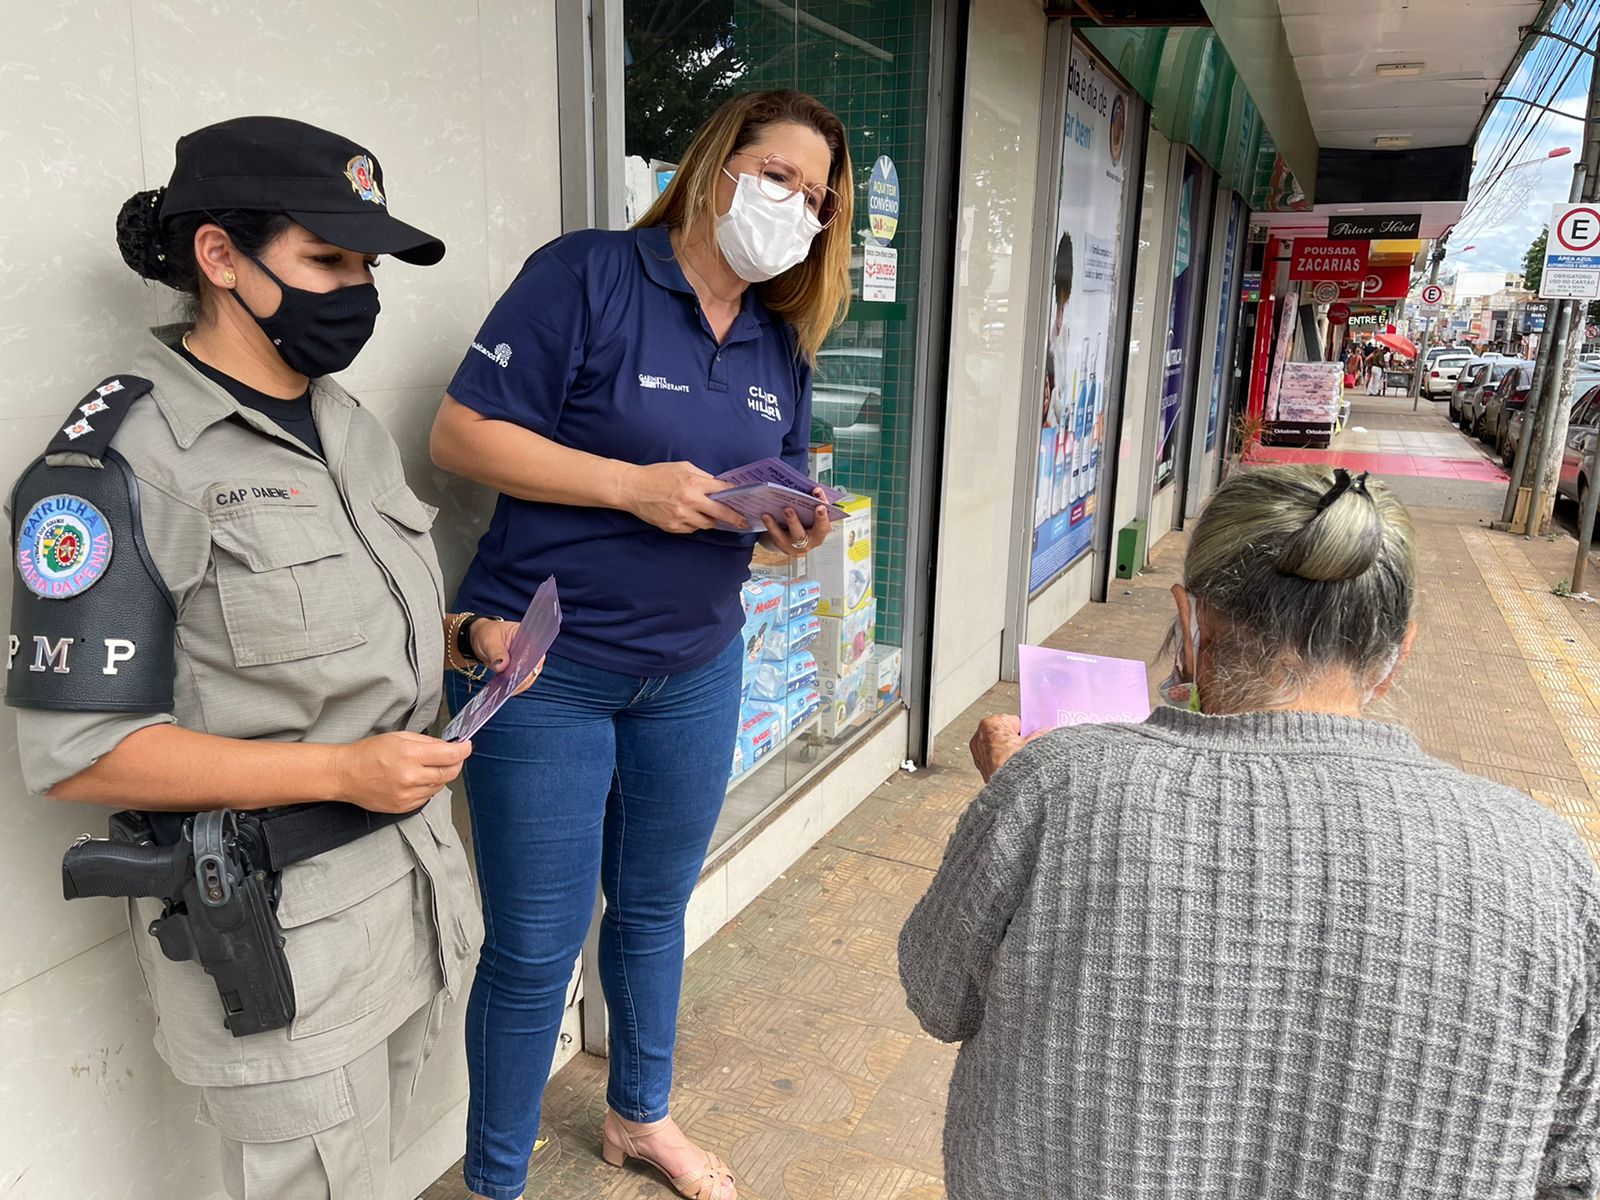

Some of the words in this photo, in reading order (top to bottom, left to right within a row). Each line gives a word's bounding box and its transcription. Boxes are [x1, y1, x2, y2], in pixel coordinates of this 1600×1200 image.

[1098, 85, 1107, 117] de
[1332, 222, 1375, 236] Palace
[1379, 220, 1416, 233] Hotel
[1571, 219, 1590, 240] E
[1304, 246, 1357, 255] POUSADA
[1297, 257, 1361, 272] ZACARIAS
[1428, 289, 1436, 300] E
[1348, 315, 1377, 325] ENTRE
[216, 488, 247, 506] CAP
[23, 498, 100, 539] PATRULHA
[20, 549, 48, 593] MARIA
[51, 580, 76, 594] DA
[73, 532, 109, 588] PENHA
